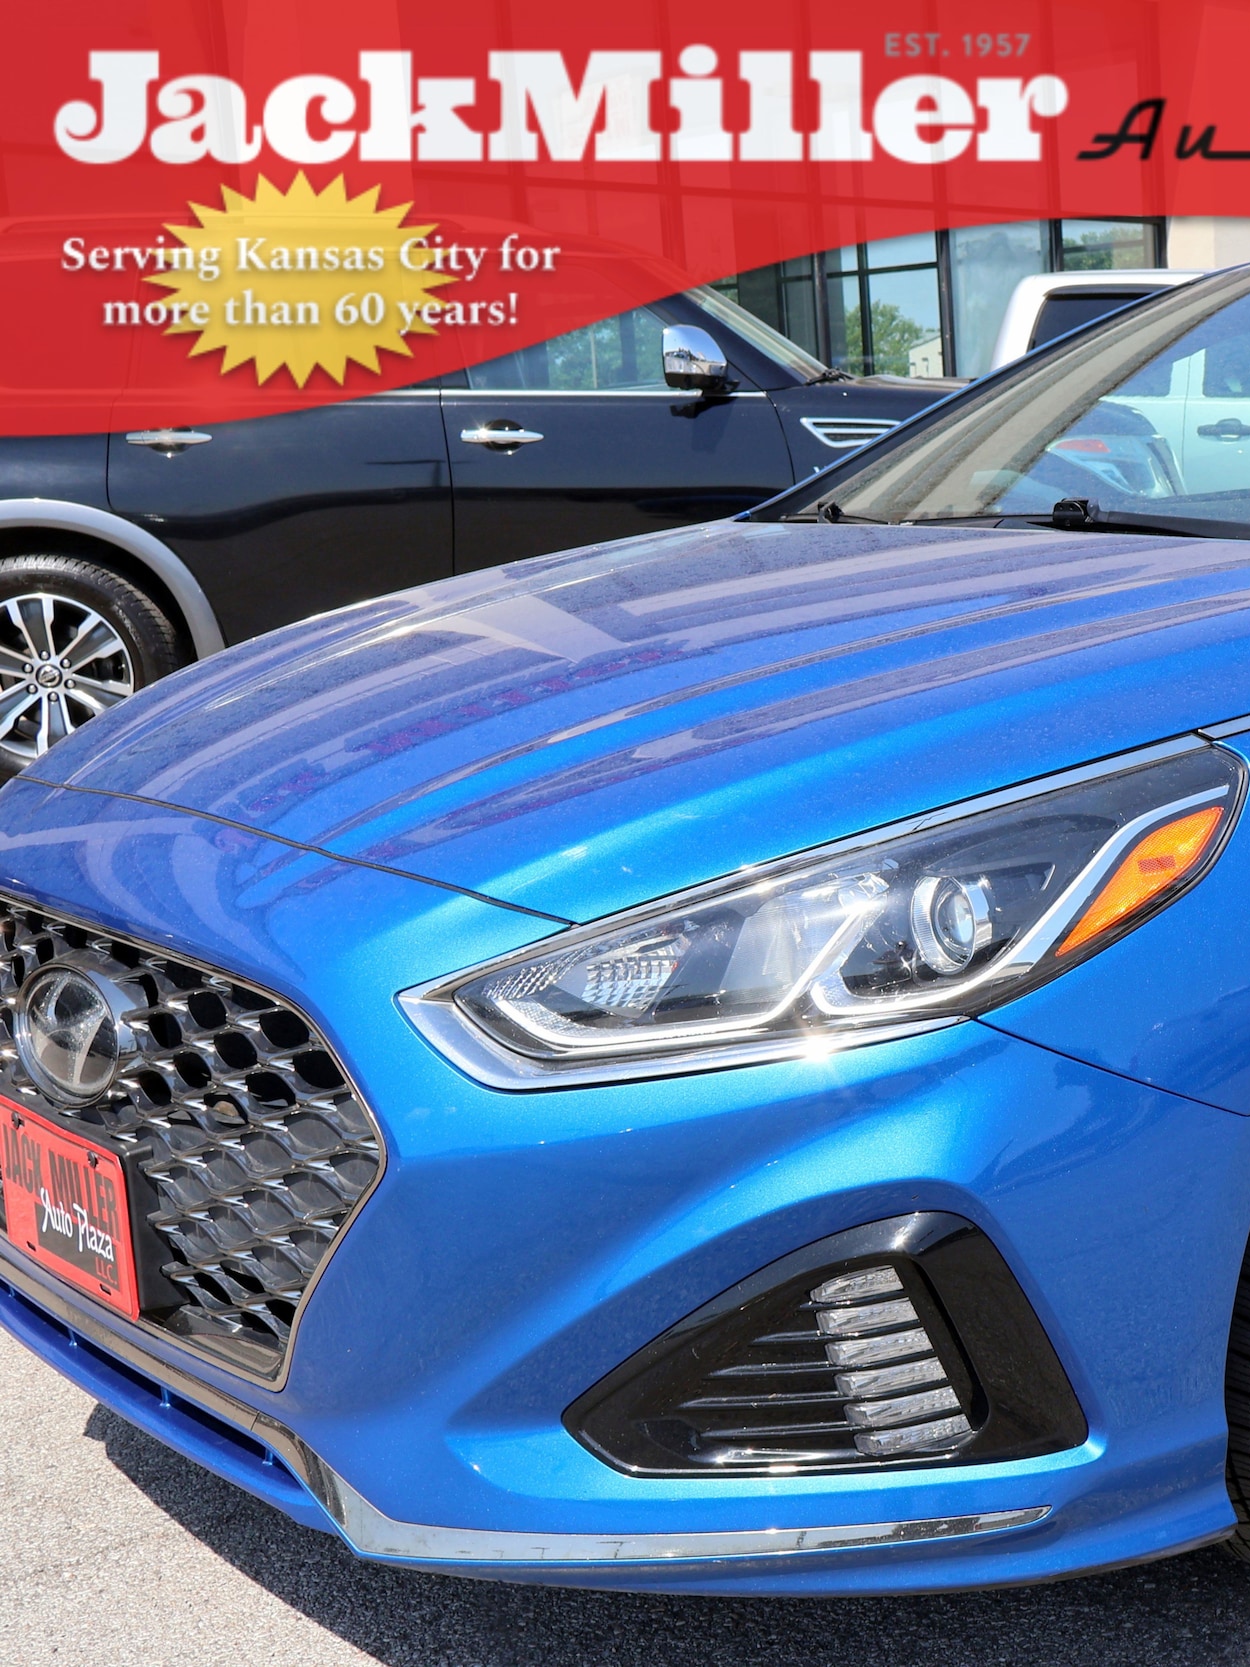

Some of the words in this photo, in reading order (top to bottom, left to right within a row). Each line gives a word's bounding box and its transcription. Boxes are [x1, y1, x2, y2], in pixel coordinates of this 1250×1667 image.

[3, 1122, 43, 1197] JACK
[48, 1148, 120, 1243] MILLER
[40, 1187, 73, 1238] Auto
[73, 1203, 114, 1262] Plaza
